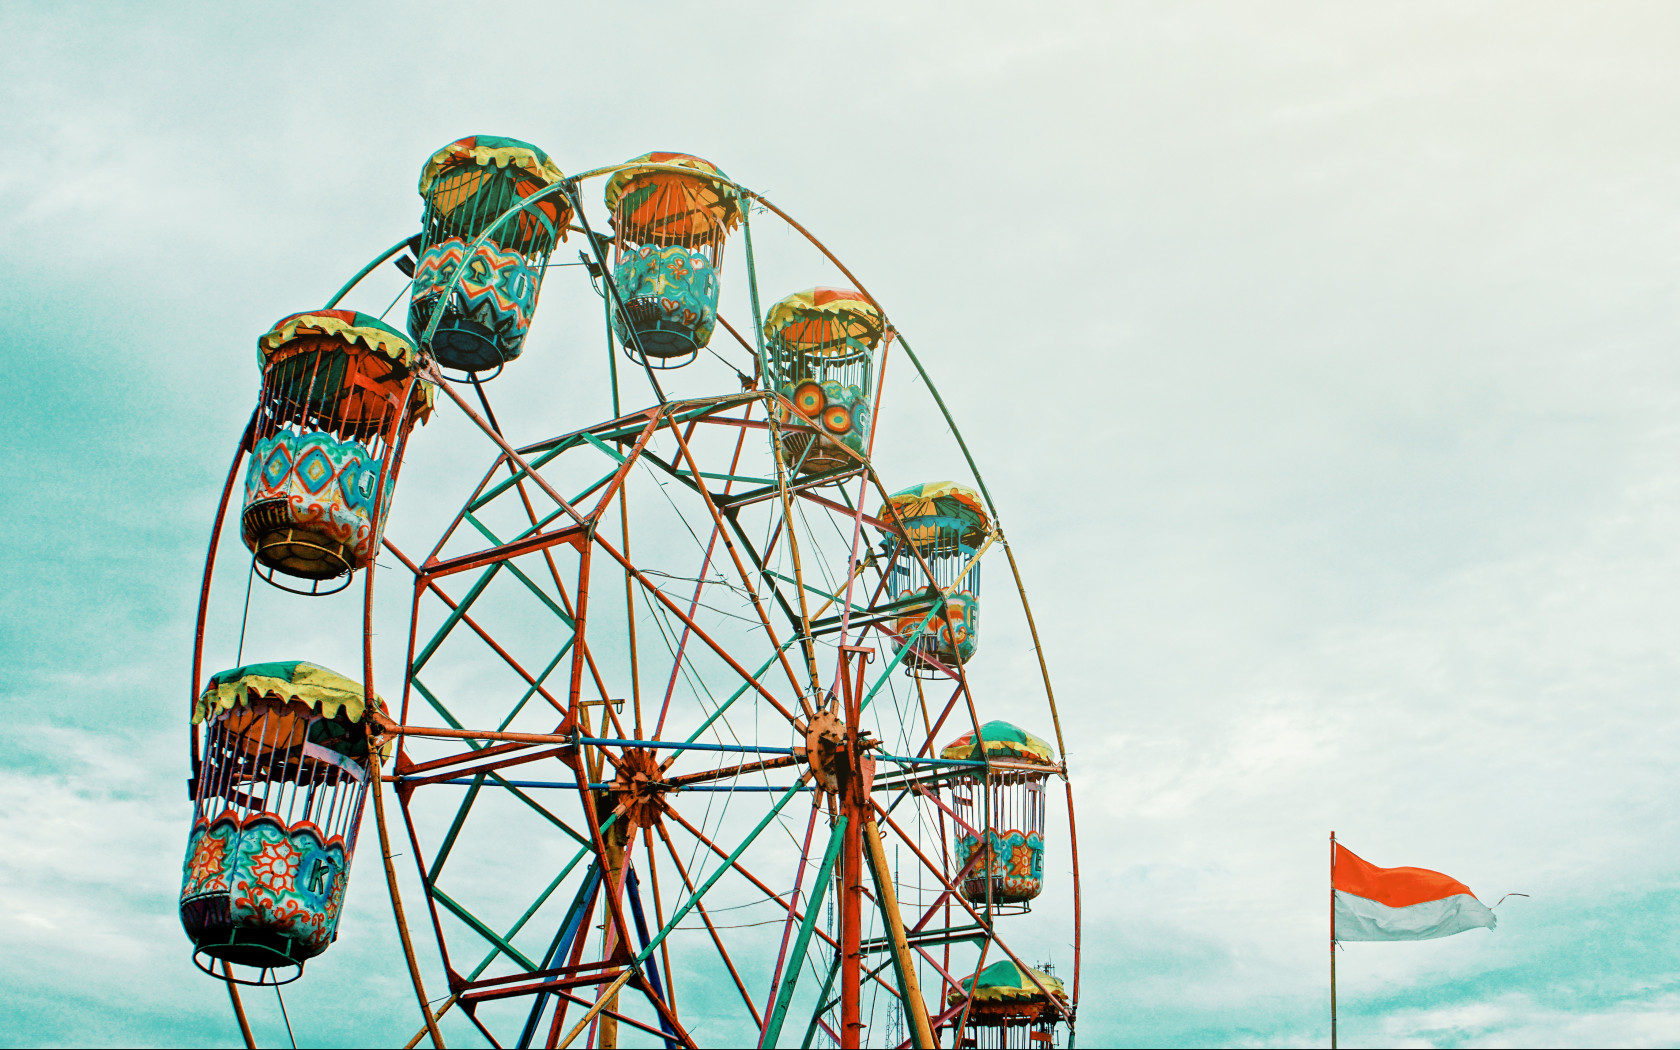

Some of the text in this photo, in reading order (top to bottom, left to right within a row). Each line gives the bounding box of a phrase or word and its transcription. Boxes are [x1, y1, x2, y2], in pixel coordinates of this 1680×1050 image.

[359, 475, 375, 499] J
[1035, 848, 1044, 872] E
[308, 858, 329, 895] K
